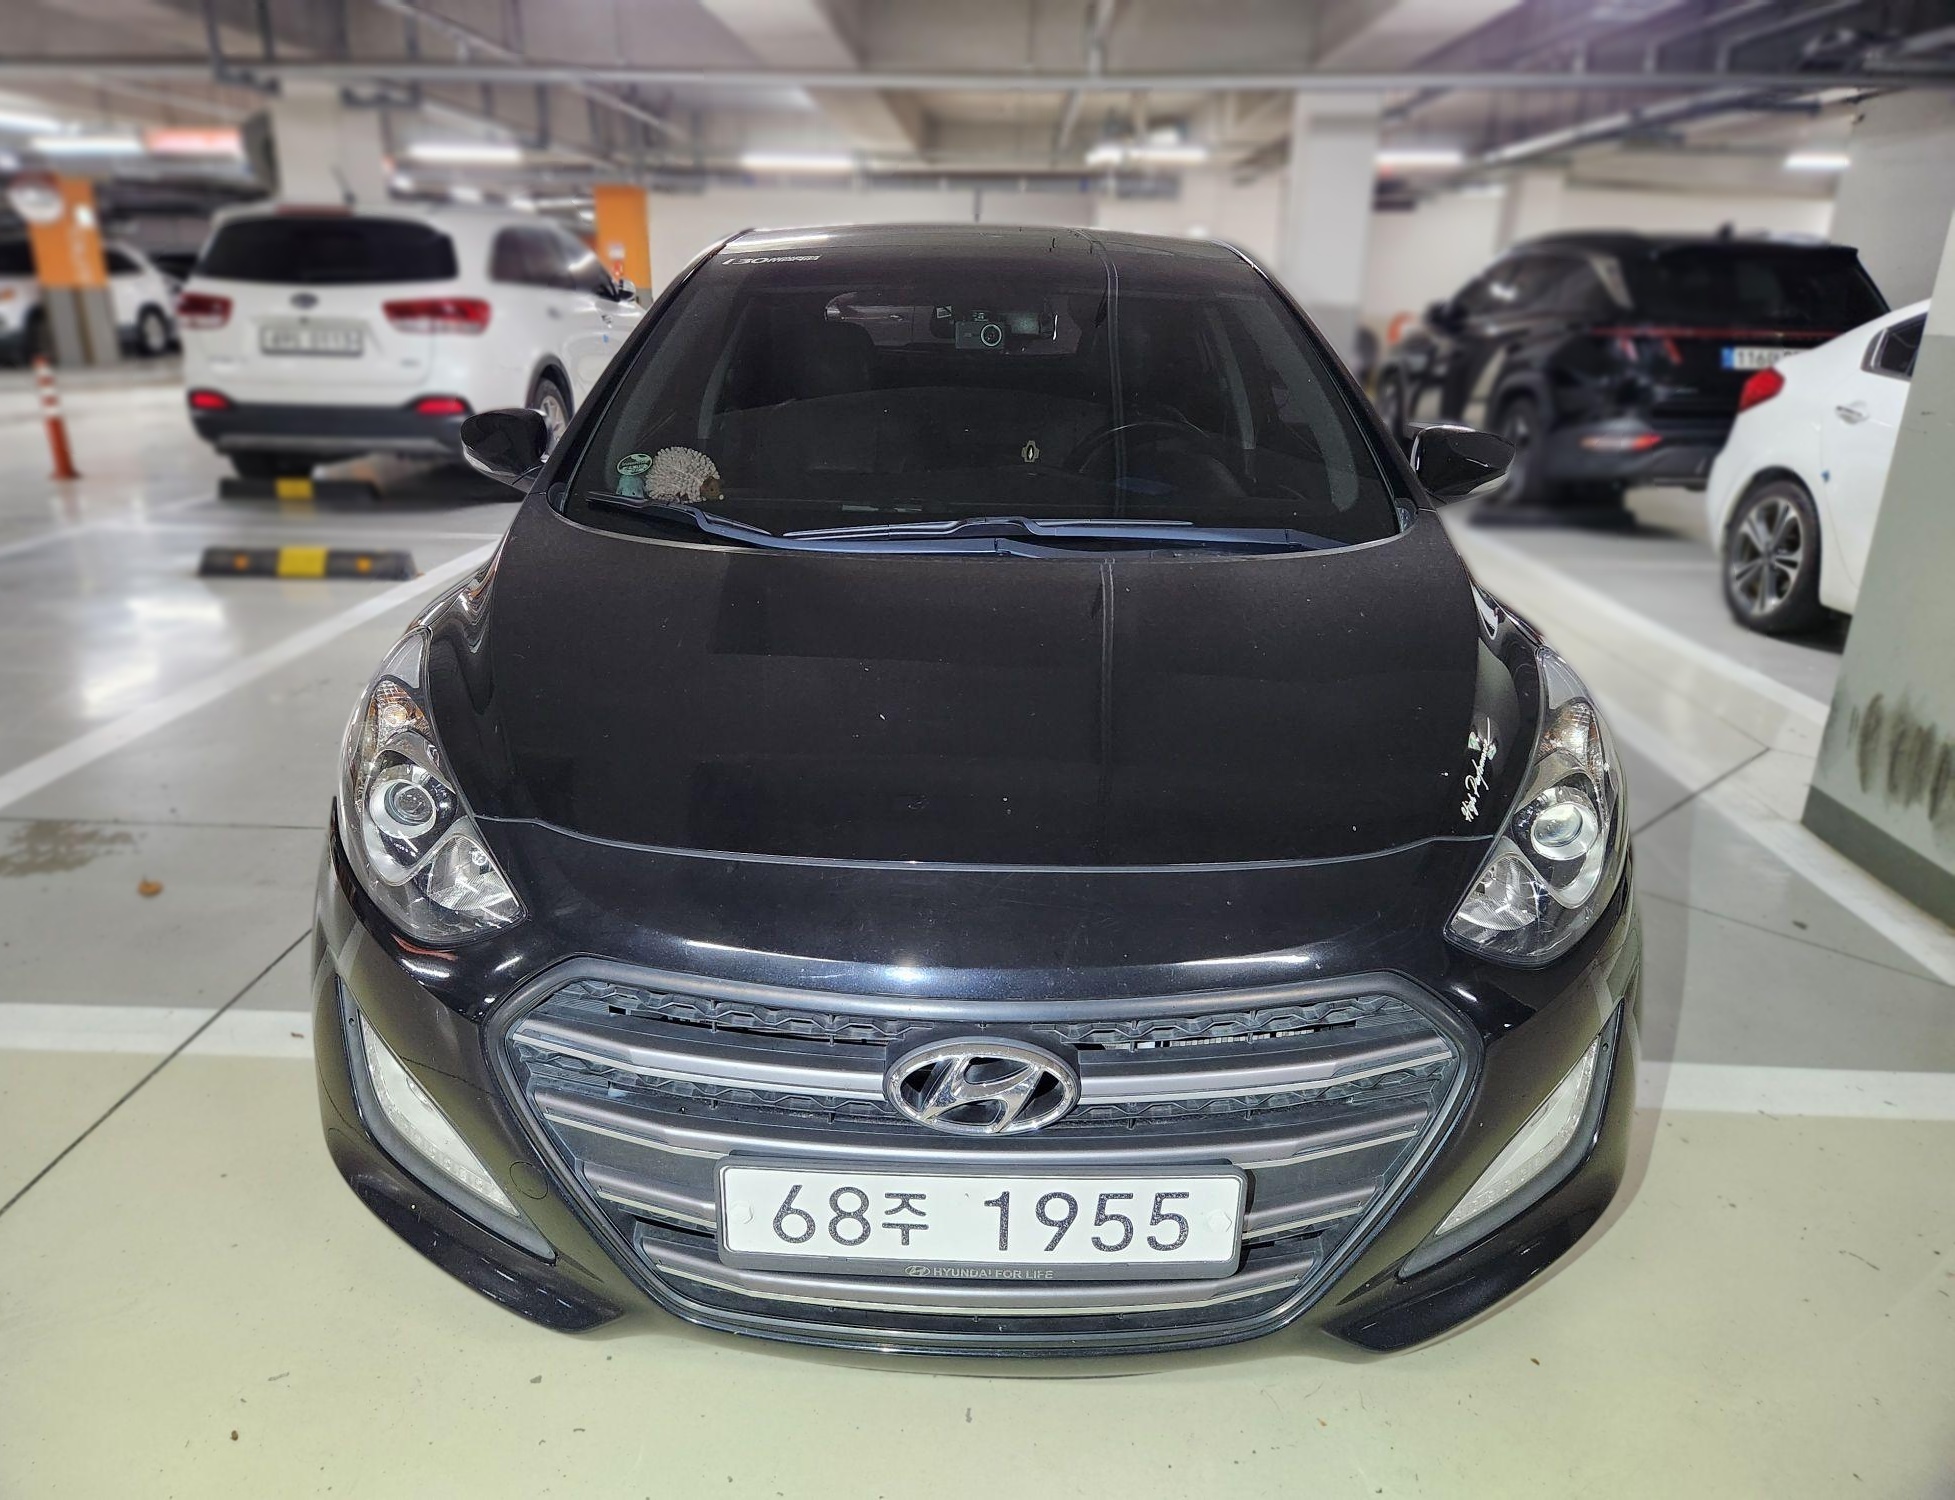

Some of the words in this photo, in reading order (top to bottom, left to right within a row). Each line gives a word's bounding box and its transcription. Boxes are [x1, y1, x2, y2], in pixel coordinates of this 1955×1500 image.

[773, 1184, 929, 1246] 68주
[984, 1190, 1190, 1252] 1955
[995, 1269, 1022, 1279] FOR
[1025, 1270, 1054, 1279] LIFE
